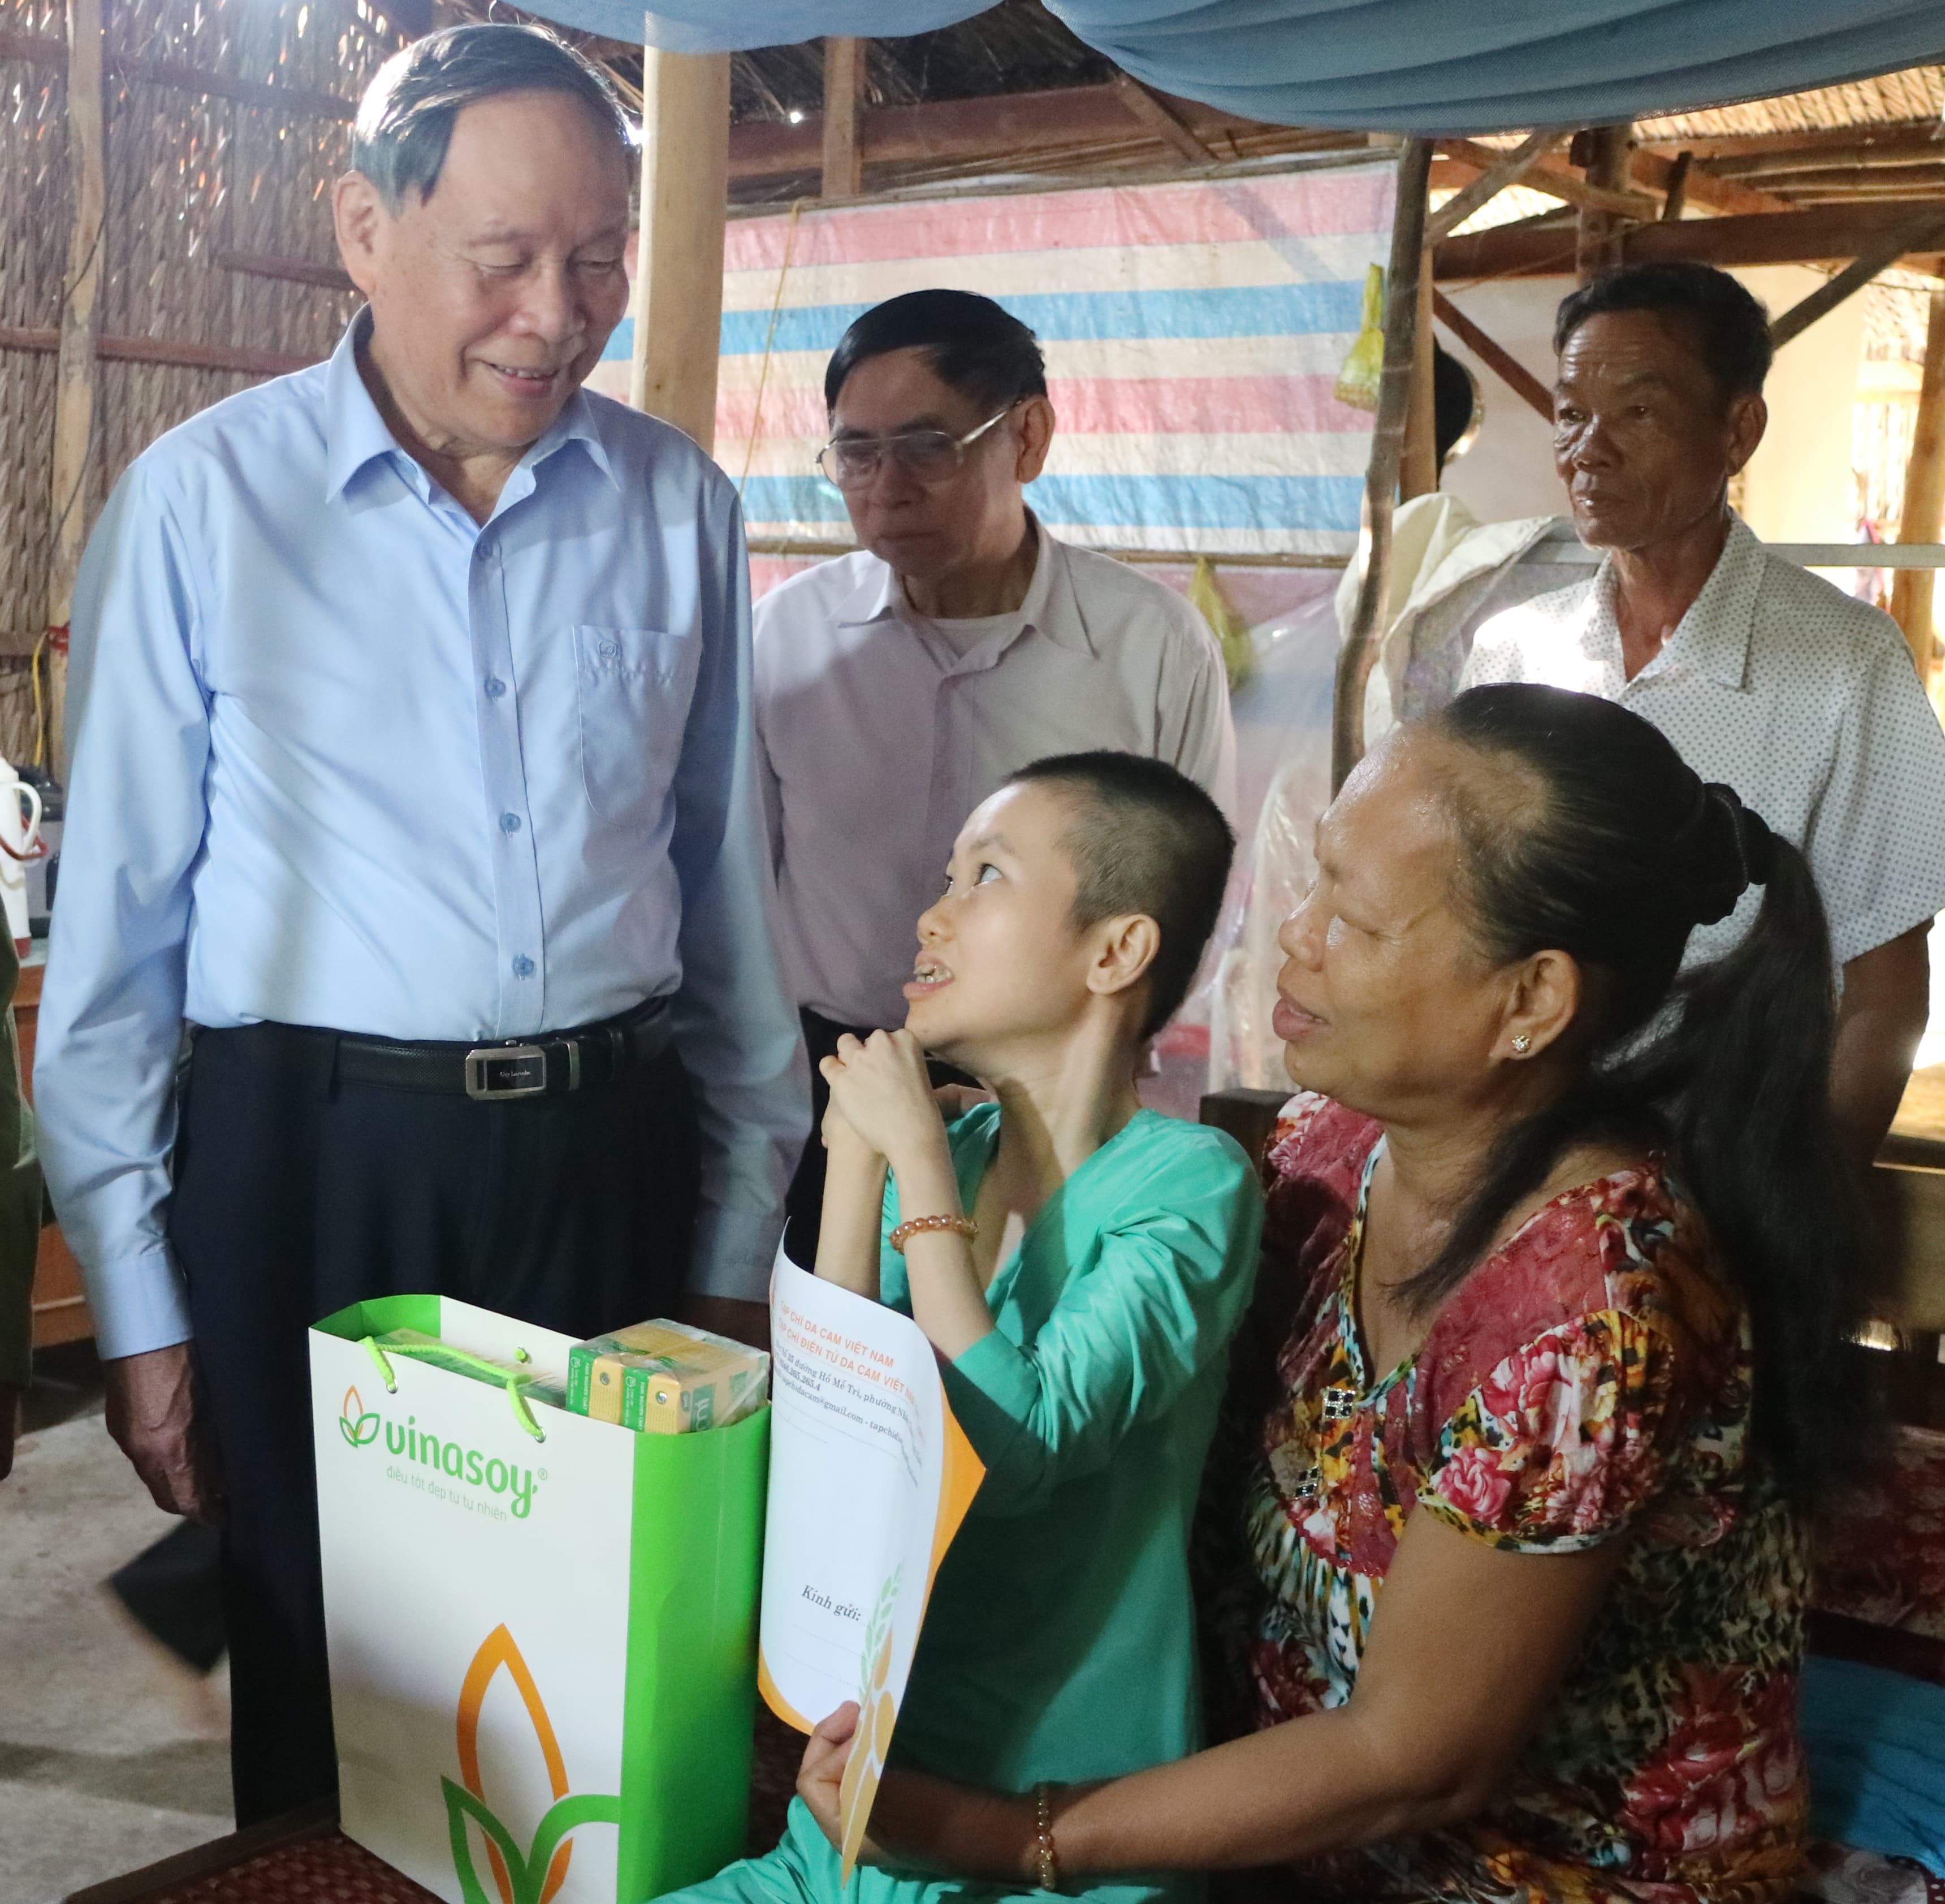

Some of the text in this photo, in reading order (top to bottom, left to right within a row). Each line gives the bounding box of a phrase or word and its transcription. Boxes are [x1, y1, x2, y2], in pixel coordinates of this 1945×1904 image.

[805, 1320, 817, 1334] DA
[820, 1328, 842, 1345] CAM
[845, 1338, 868, 1356] VIỆT
[870, 1349, 894, 1368] NAM
[840, 1356, 854, 1371] DA
[857, 1364, 881, 1382] CAM
[884, 1375, 905, 1394] VIỆT
[386, 1416, 538, 1518] vinasoy
[801, 1585, 862, 1621] Kính gửi:
